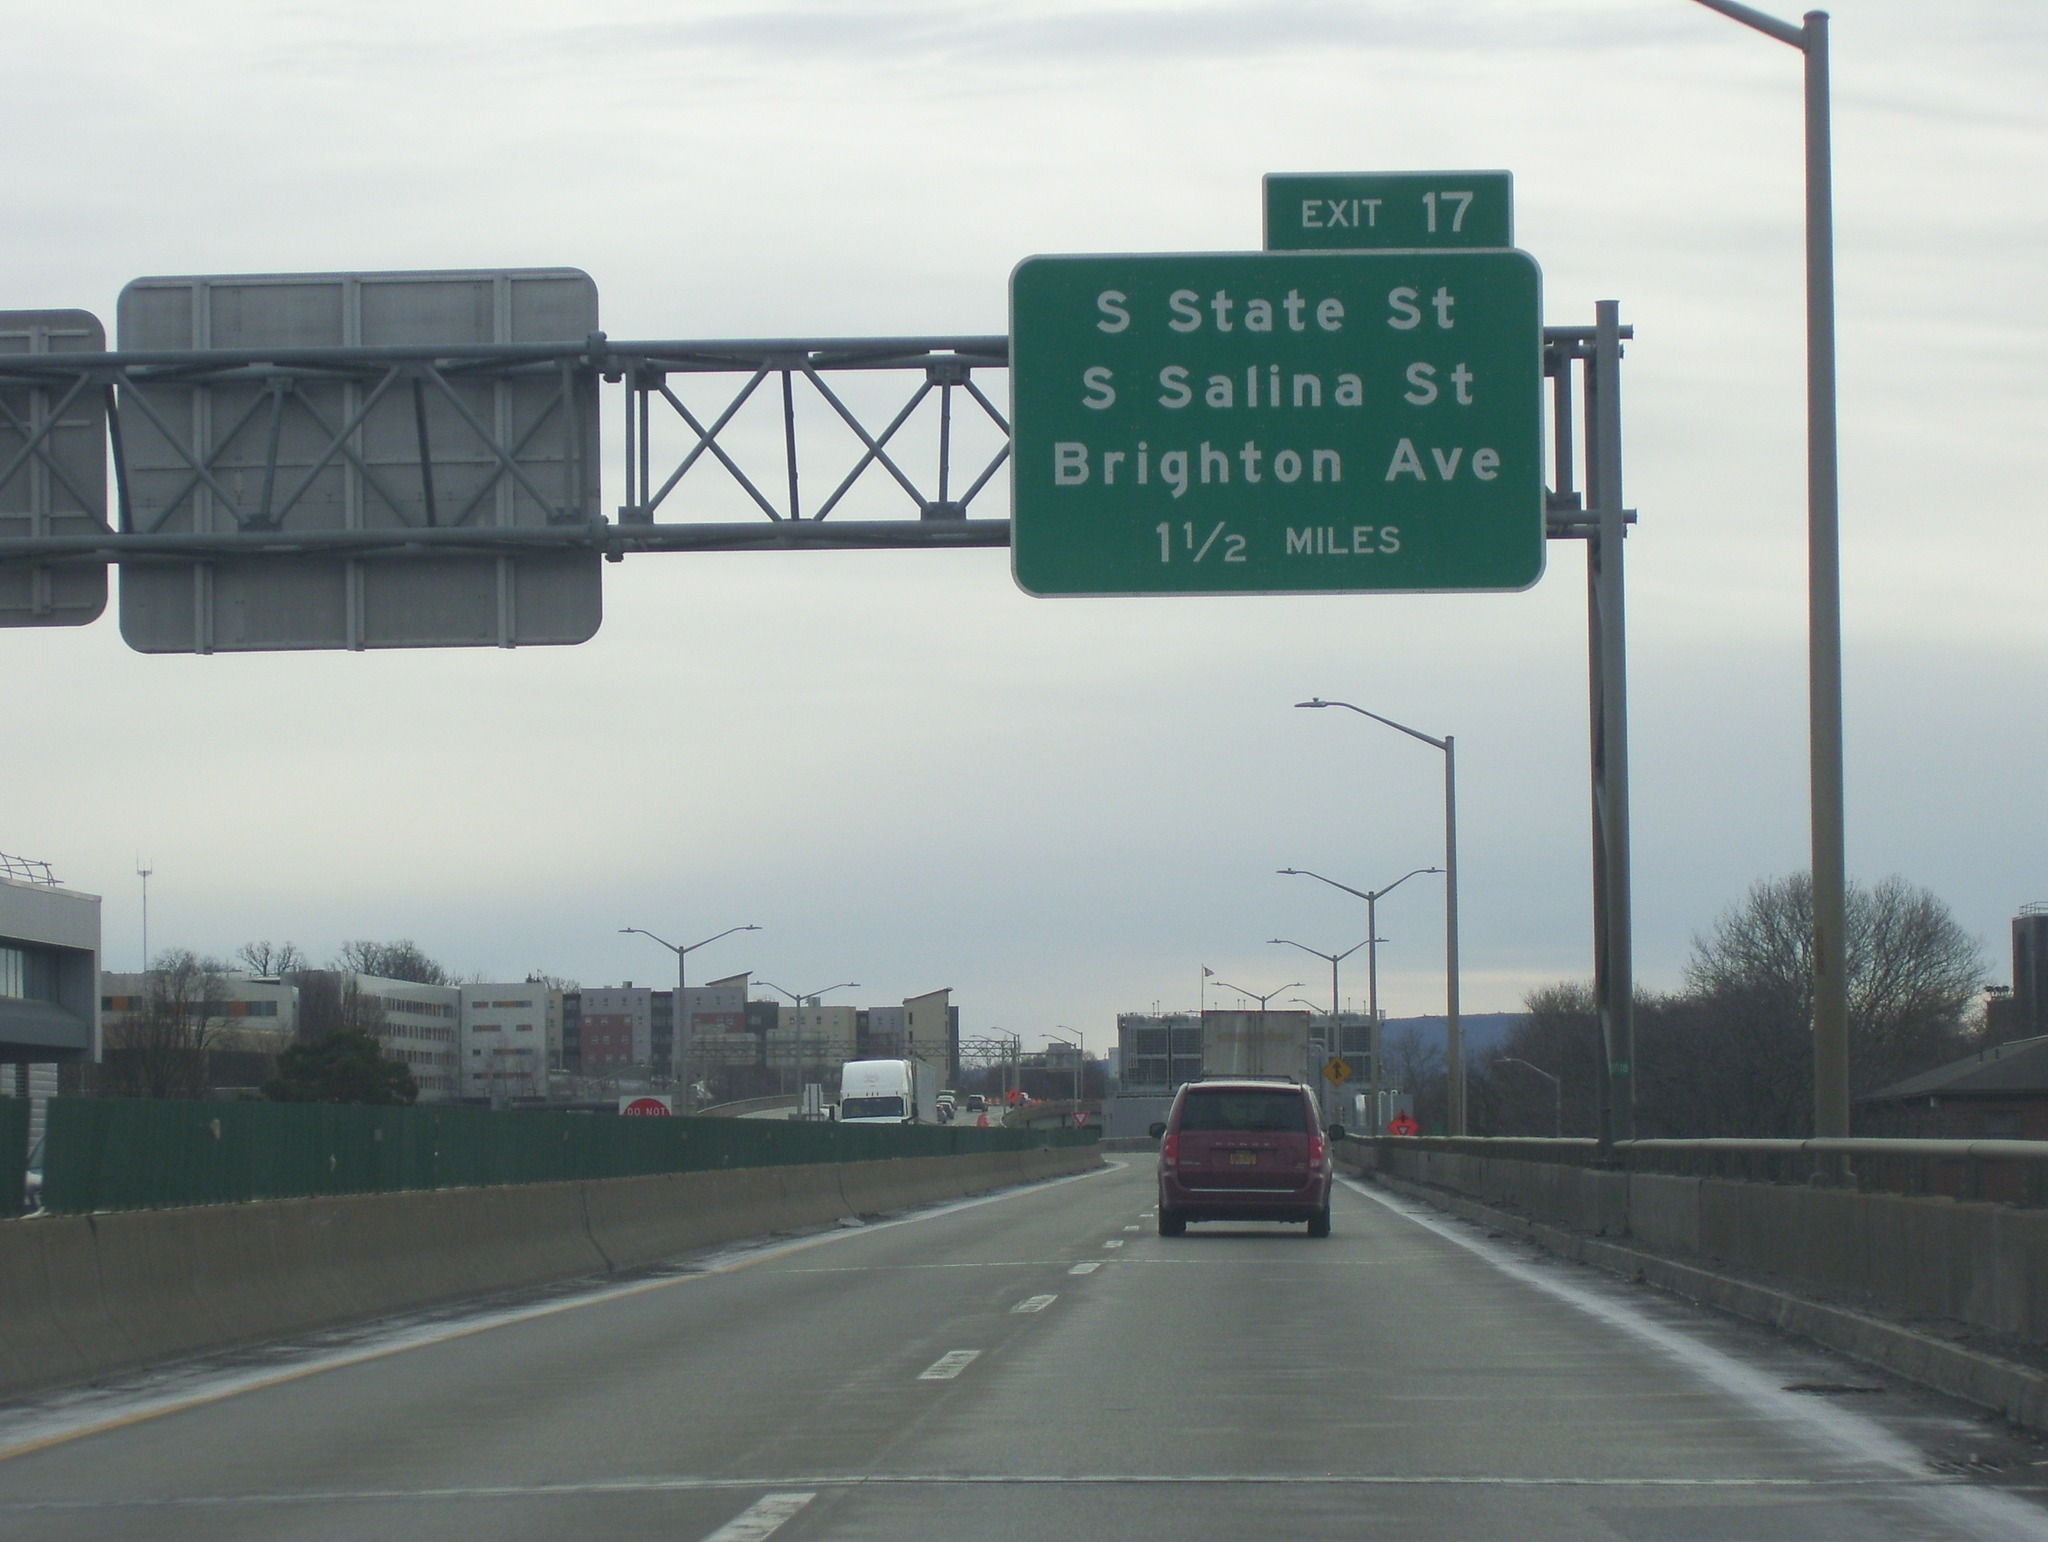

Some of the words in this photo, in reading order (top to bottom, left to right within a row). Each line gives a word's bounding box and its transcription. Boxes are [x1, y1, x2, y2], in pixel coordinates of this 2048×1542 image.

[1303, 199, 1382, 227] EXIT
[1423, 191, 1473, 232] 17
[1096, 290, 1130, 333] S
[1168, 289, 1345, 333] State
[1387, 286, 1455, 330] St
[1082, 366, 1116, 409] S
[1158, 364, 1363, 409] Salina
[1404, 362, 1474, 405] St
[1055, 441, 1342, 499] Brighton
[1385, 438, 1501, 482] Ave
[1286, 526, 1401, 555] MILES
[627, 1107, 641, 1116] DO
[646, 1107, 666, 1116] NOT
